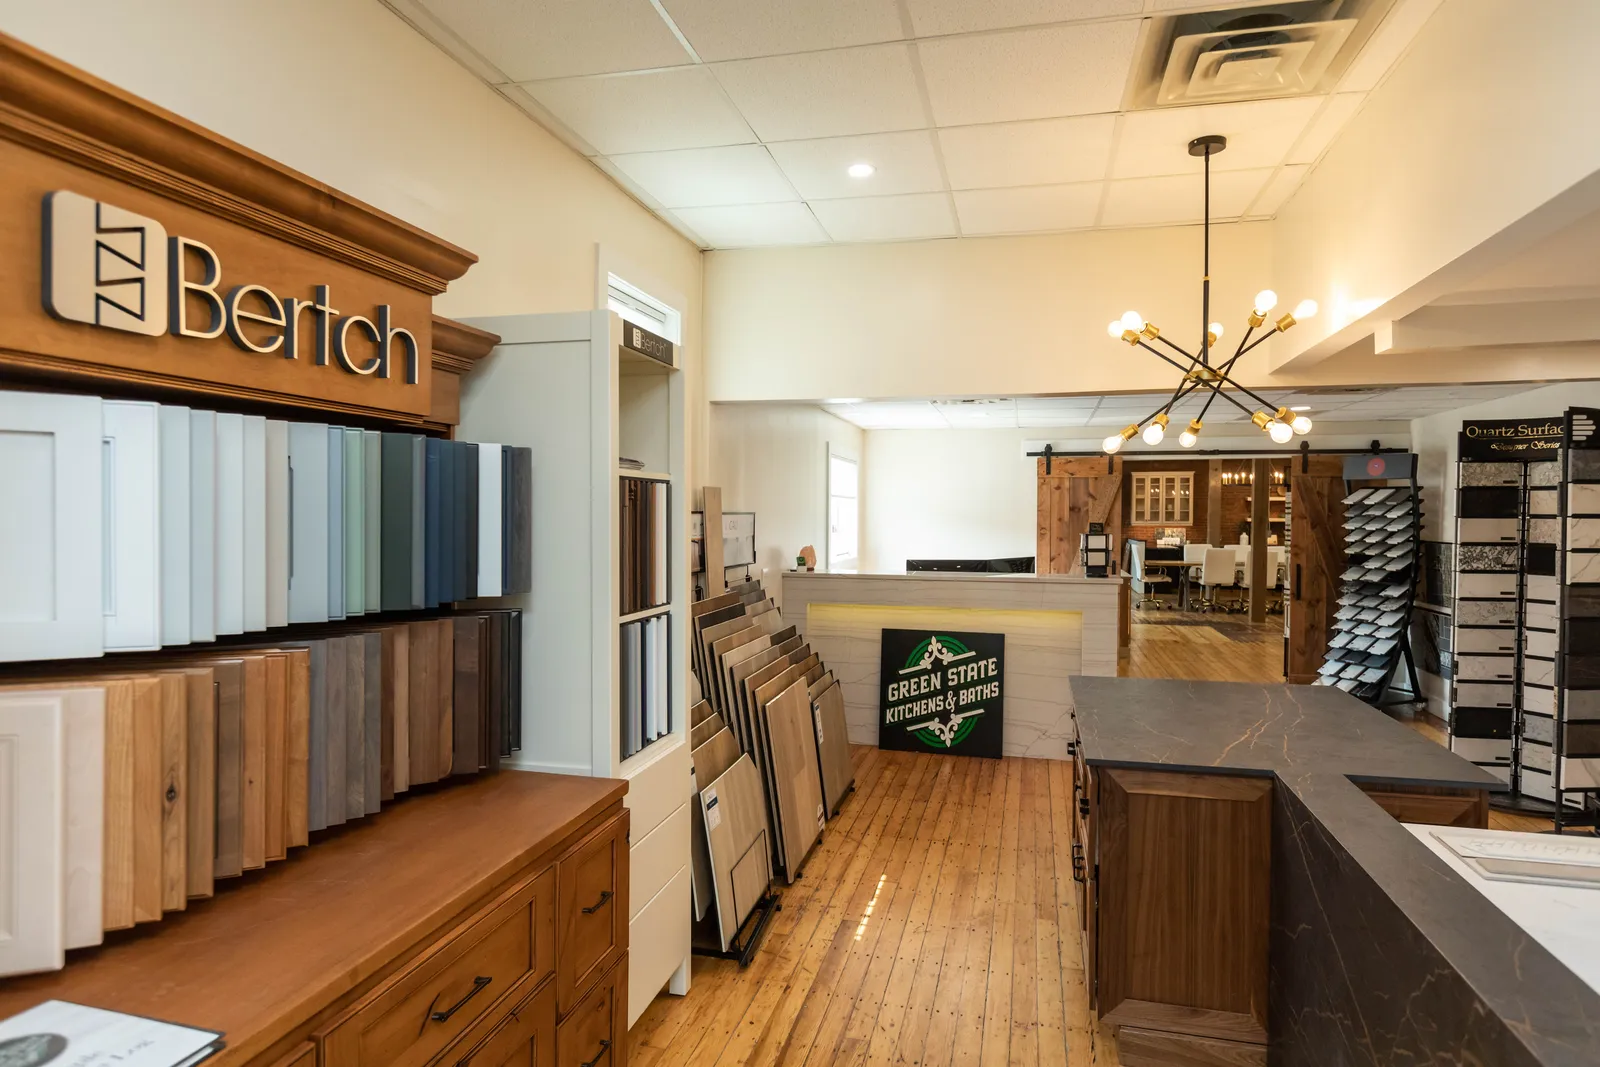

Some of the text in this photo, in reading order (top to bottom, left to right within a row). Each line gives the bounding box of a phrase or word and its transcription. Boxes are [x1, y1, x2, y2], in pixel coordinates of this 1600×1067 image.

[168, 236, 419, 385] Bertch
[1466, 426, 1515, 438] Quartz
[1531, 440, 1561, 450] Series
[888, 657, 998, 702] GREEN STATE
[886, 681, 999, 724] KITCHENS & BATHS
